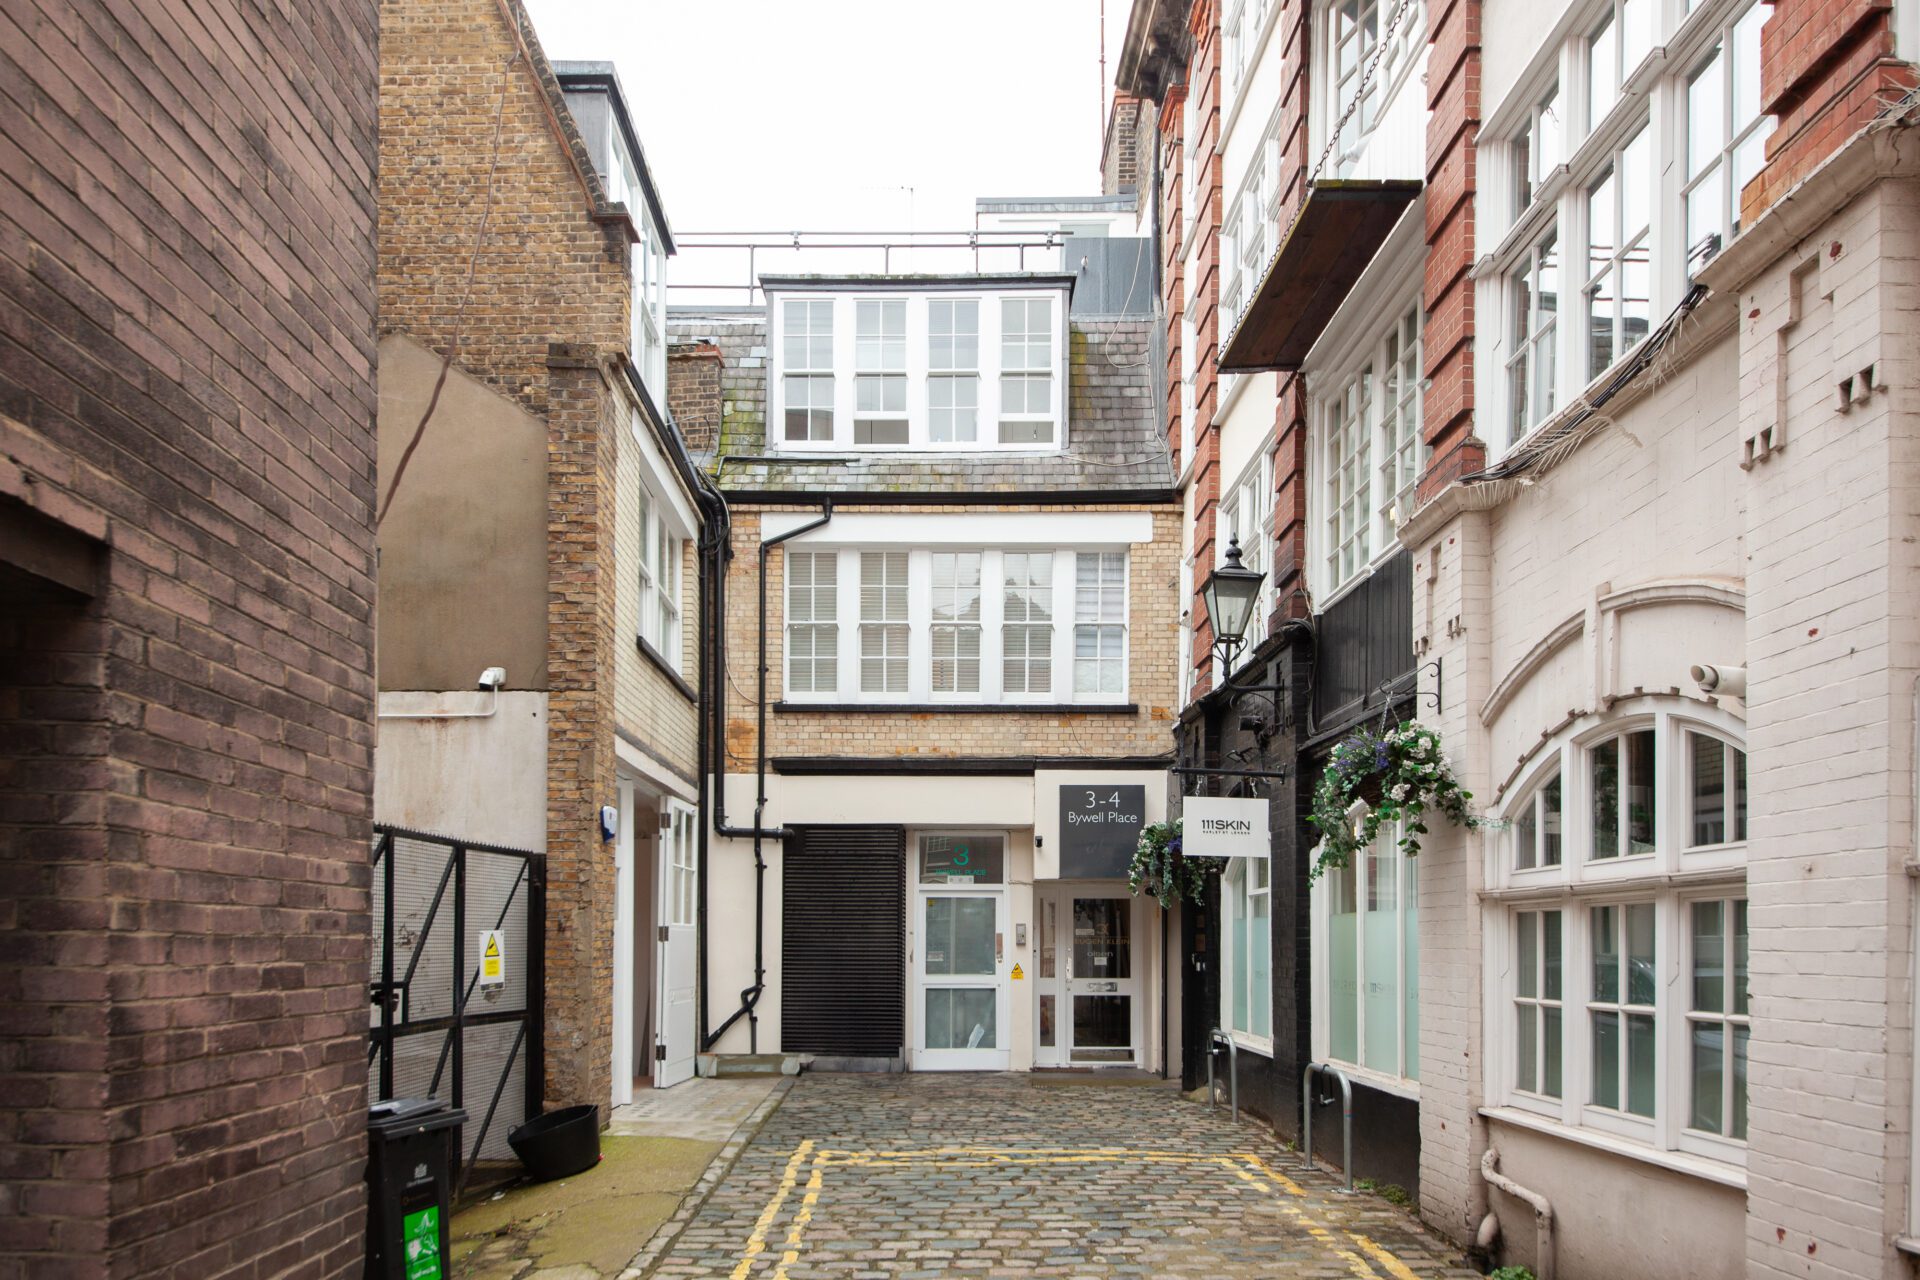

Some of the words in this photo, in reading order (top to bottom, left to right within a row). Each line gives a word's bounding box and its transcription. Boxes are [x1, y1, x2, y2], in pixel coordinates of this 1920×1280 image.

[1085, 790, 1120, 808] 3-4
[1068, 811, 1104, 826] Bywell
[1108, 811, 1138, 823] Place
[1201, 819, 1250, 830] 111SKIN
[953, 845, 969, 866] 3
